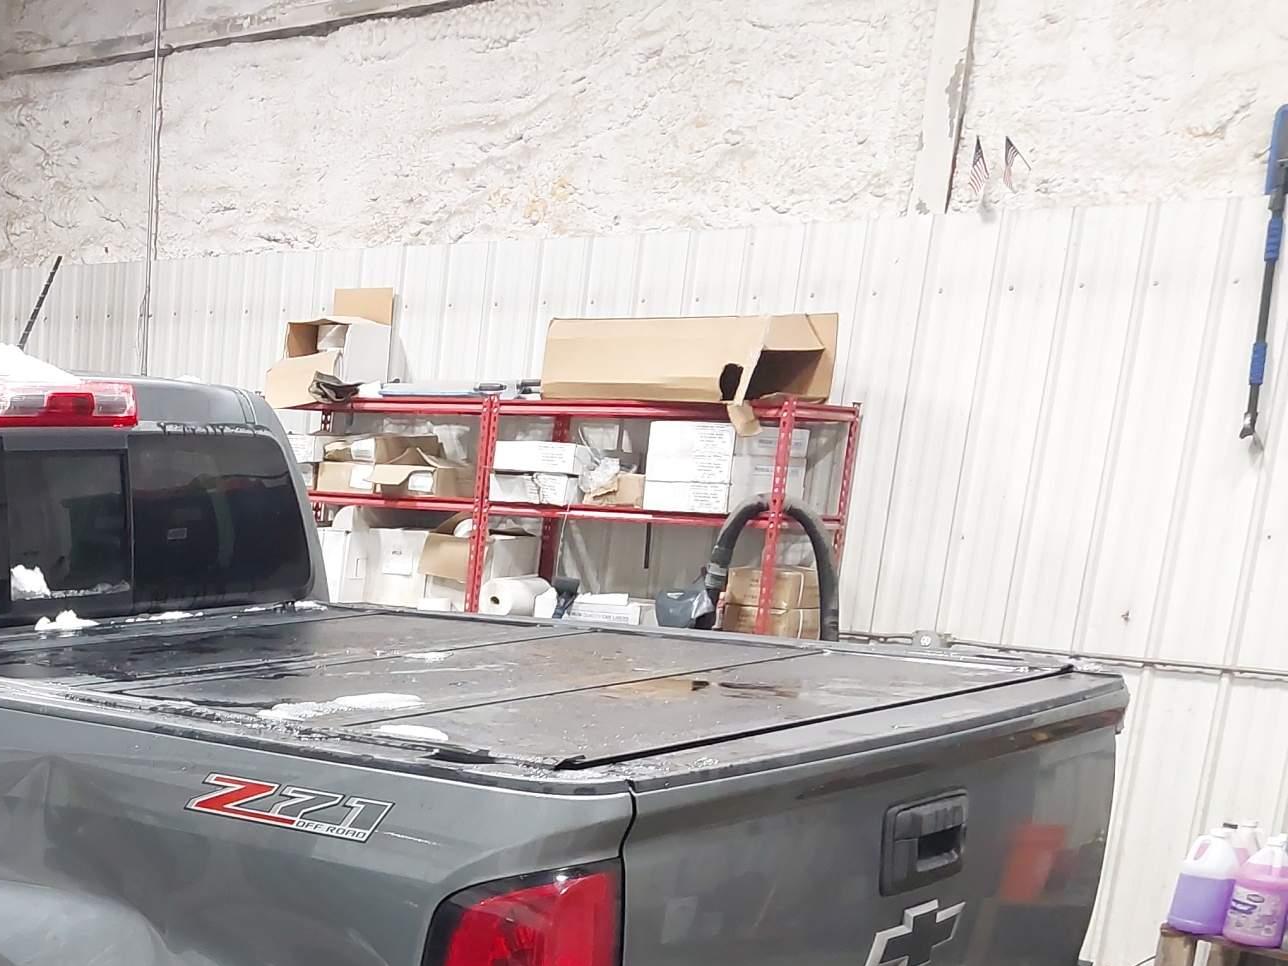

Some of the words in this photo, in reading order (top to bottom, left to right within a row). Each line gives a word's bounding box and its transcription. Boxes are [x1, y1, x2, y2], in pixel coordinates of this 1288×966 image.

[185, 773, 395, 834] Z71
[296, 820, 324, 831] OFF
[326, 825, 367, 839] ROAD
